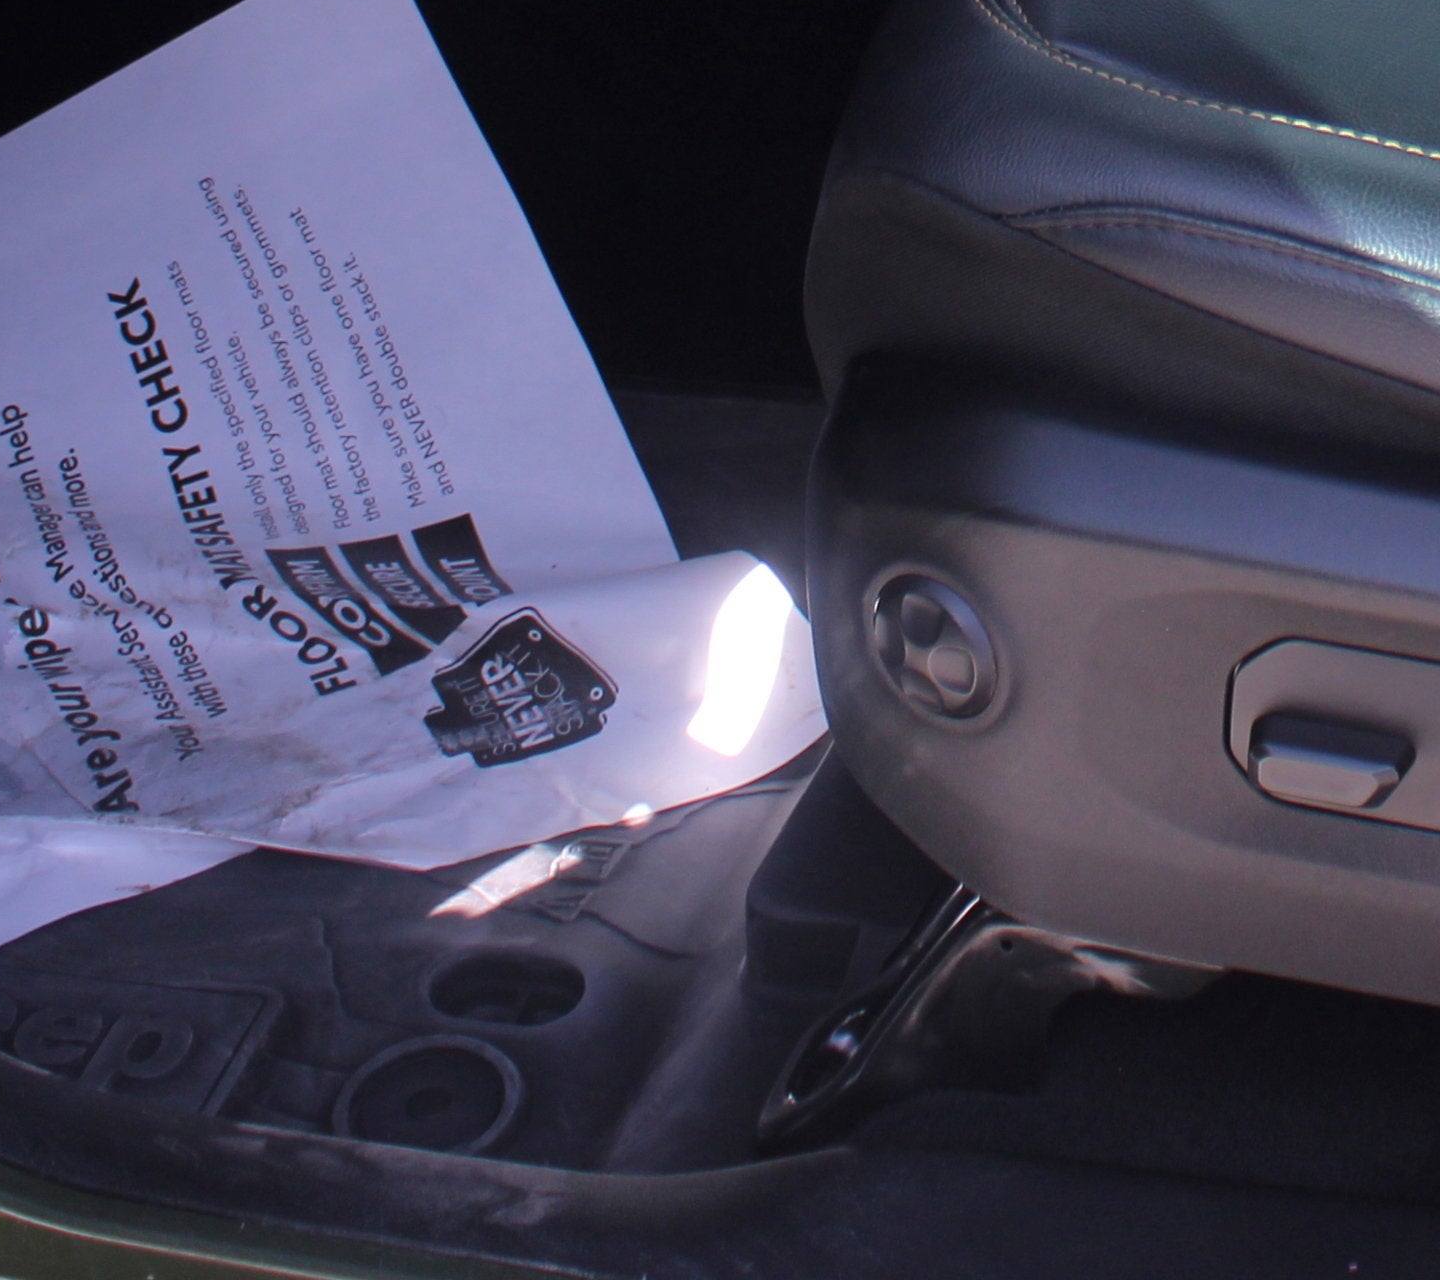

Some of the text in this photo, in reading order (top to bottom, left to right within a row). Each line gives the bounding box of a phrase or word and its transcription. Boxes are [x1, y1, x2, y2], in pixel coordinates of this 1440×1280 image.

[196, 175, 353, 531] Floor mat should always be secured using
[233, 179, 382, 523] the factory retention clips or grommets.
[288, 206, 427, 510] Make sure you have one floor mat
[342, 248, 456, 497] and NEVER double stack it.
[166, 259, 282, 542] Install only the specified floor mats
[226, 326, 312, 536] designed for your vehicle.
[18, 467, 48, 502] can
[106, 277, 358, 697] FLOOR MAT SAFETY CHECK
[29, 503, 76, 585] Manager
[59, 446, 229, 720] with these questions and more.
[364, 561, 436, 608] SECURE
[437, 556, 502, 601] OUNT
[68, 579, 146, 656] Service
[47, 682, 122, 747] your
[126, 654, 186, 721] Assistant
[480, 653, 555, 749] NEVER
[85, 747, 141, 813] Are
[166, 723, 206, 764] Your
